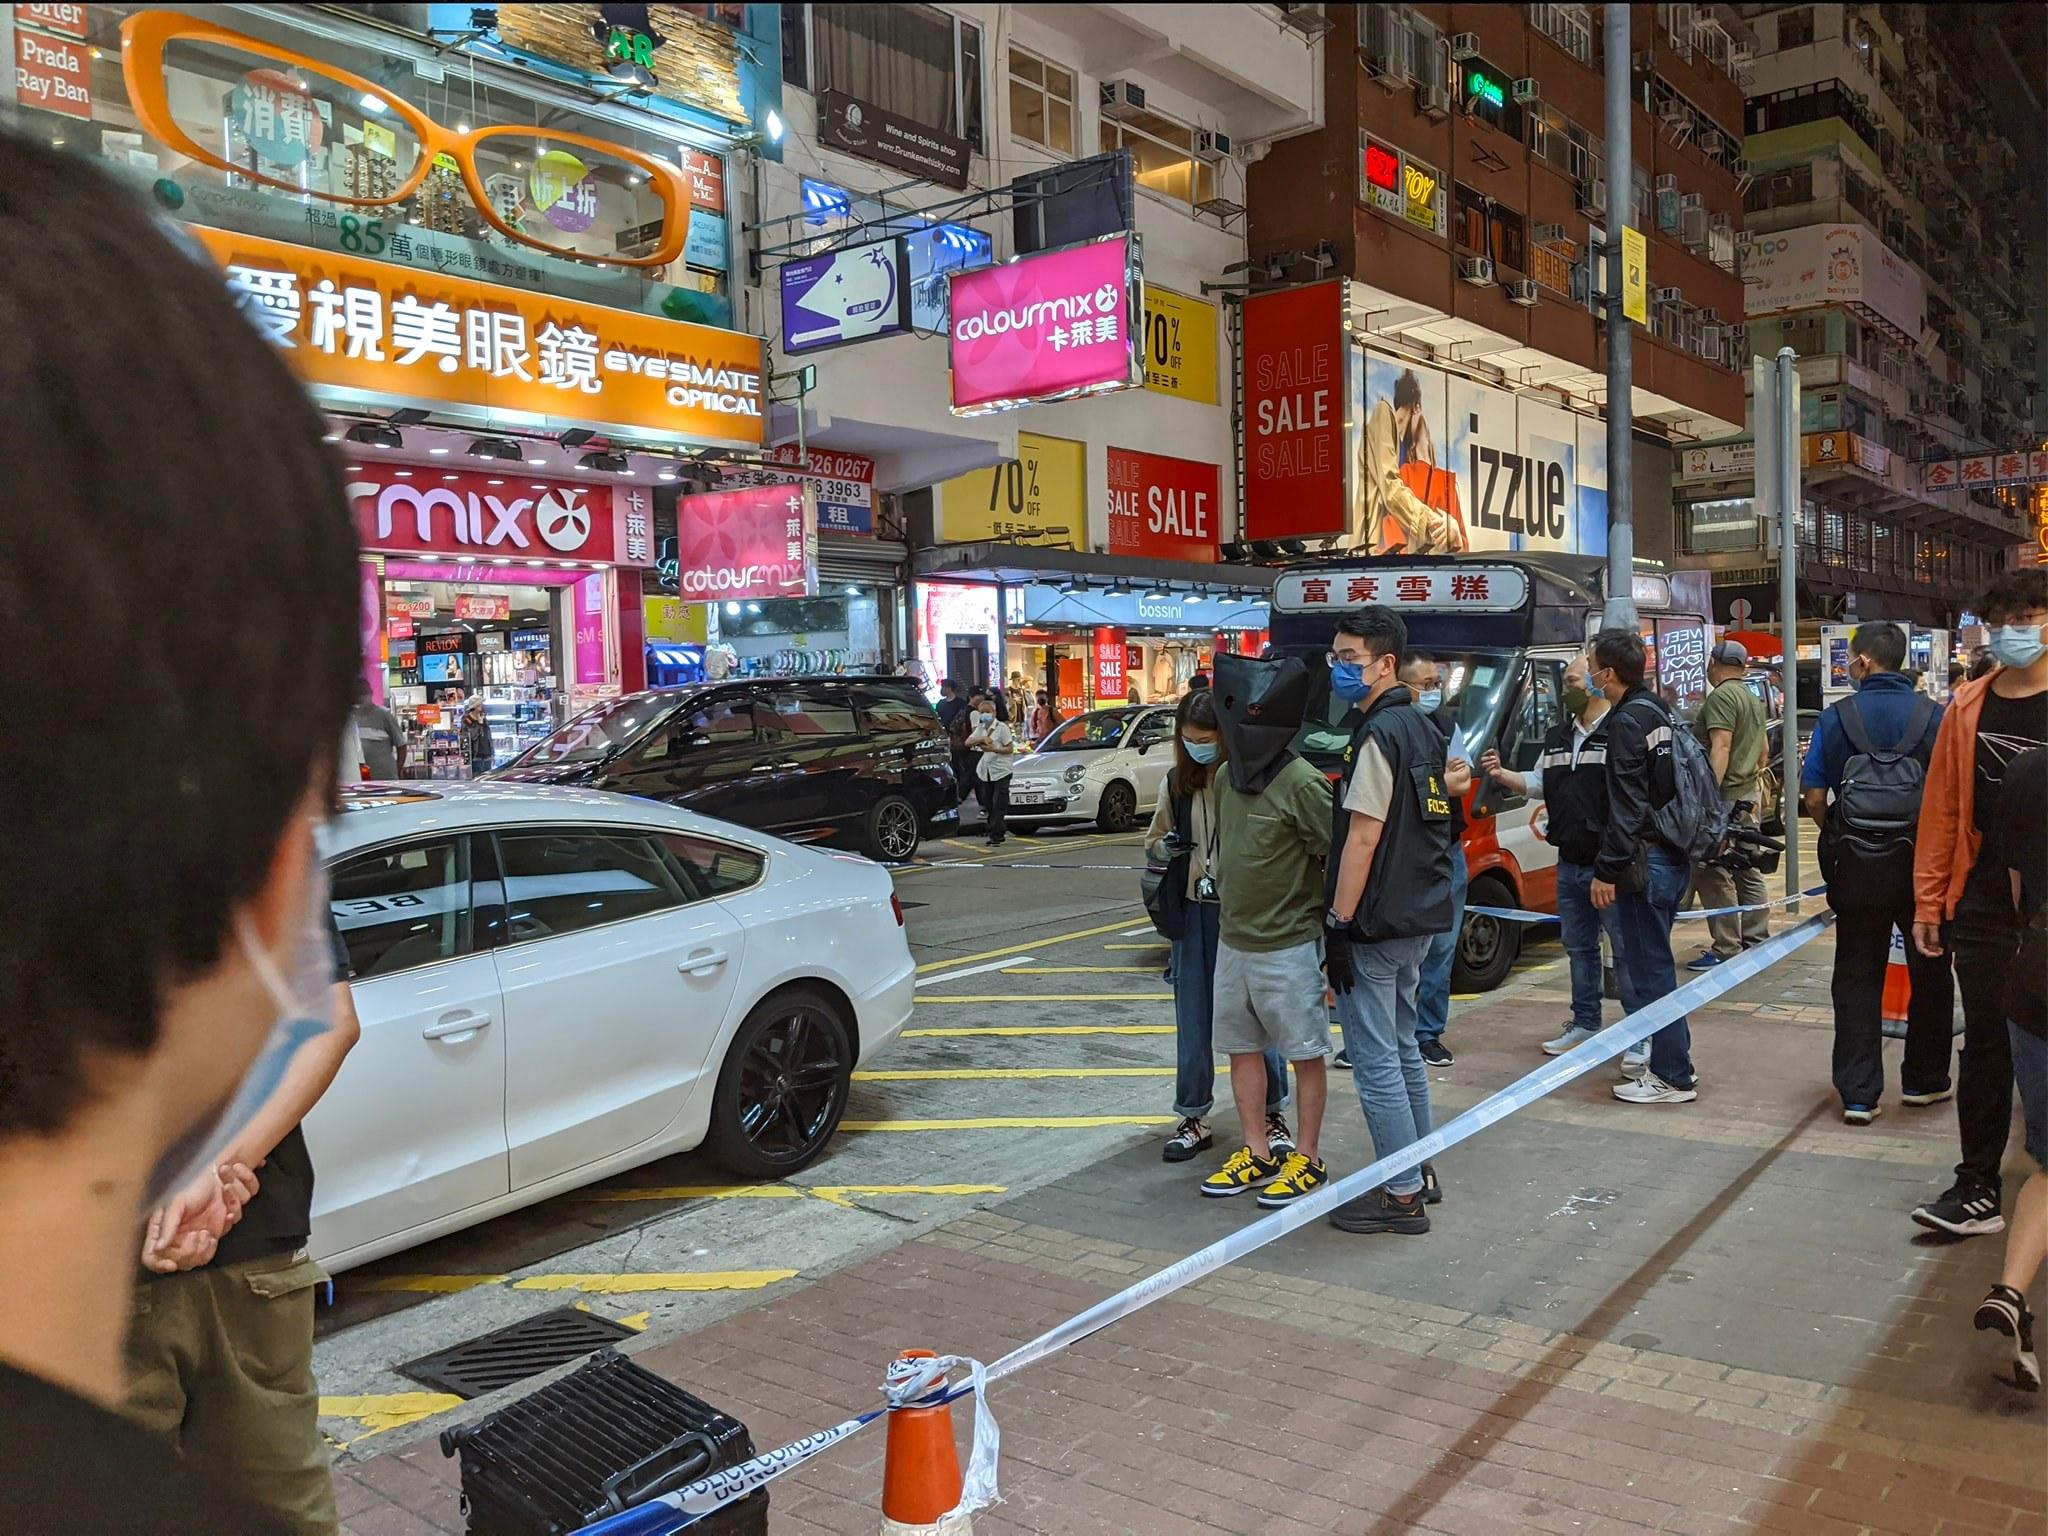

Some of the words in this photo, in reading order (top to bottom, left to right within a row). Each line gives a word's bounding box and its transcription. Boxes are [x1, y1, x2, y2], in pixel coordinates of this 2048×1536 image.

[15, 4, 83, 24] orter
[22, 38, 80, 73] Prada
[16, 67, 51, 100] Ray
[53, 76, 90, 104] Ban
[885, 123, 902, 137] Wine
[903, 130, 917, 143] and
[917, 135, 939, 151] Spirits
[940, 143, 957, 157] shop
[1405, 165, 1434, 204] TOY
[1047, 314, 1118, 352] 卡萊美
[604, 349, 760, 394] EYE'SMATE
[1170, 355, 1182, 369] OFF
[1256, 344, 1329, 393] SALE
[667, 386, 761, 416] OPTICAL
[1257, 389, 1329, 437] SALE
[835, 455, 870, 479] 0267
[1257, 433, 1330, 480] SALE
[1107, 457, 1140, 488] SALE
[1469, 412, 1565, 540] izzue
[827, 481, 861, 498] 3963
[1107, 488, 1139, 517] SALE
[1026, 501, 1041, 517] OFF
[1148, 485, 1208, 538] SALE
[627, 490, 648, 561] 卡萊美
[785, 495, 803, 561] 卡萊美
[1107, 518, 1140, 547] SALE
[1301, 574, 1489, 603] 富豪雪糕
[1138, 598, 1182, 619] bossini
[425, 639, 459, 652] REVLON
[1100, 643, 1121, 660] SALE
[1100, 661, 1121, 677] SALE
[1100, 678, 1122, 696] SALE
[1061, 697, 1083, 710] SALE
[1026, 795, 1038, 803] 612
